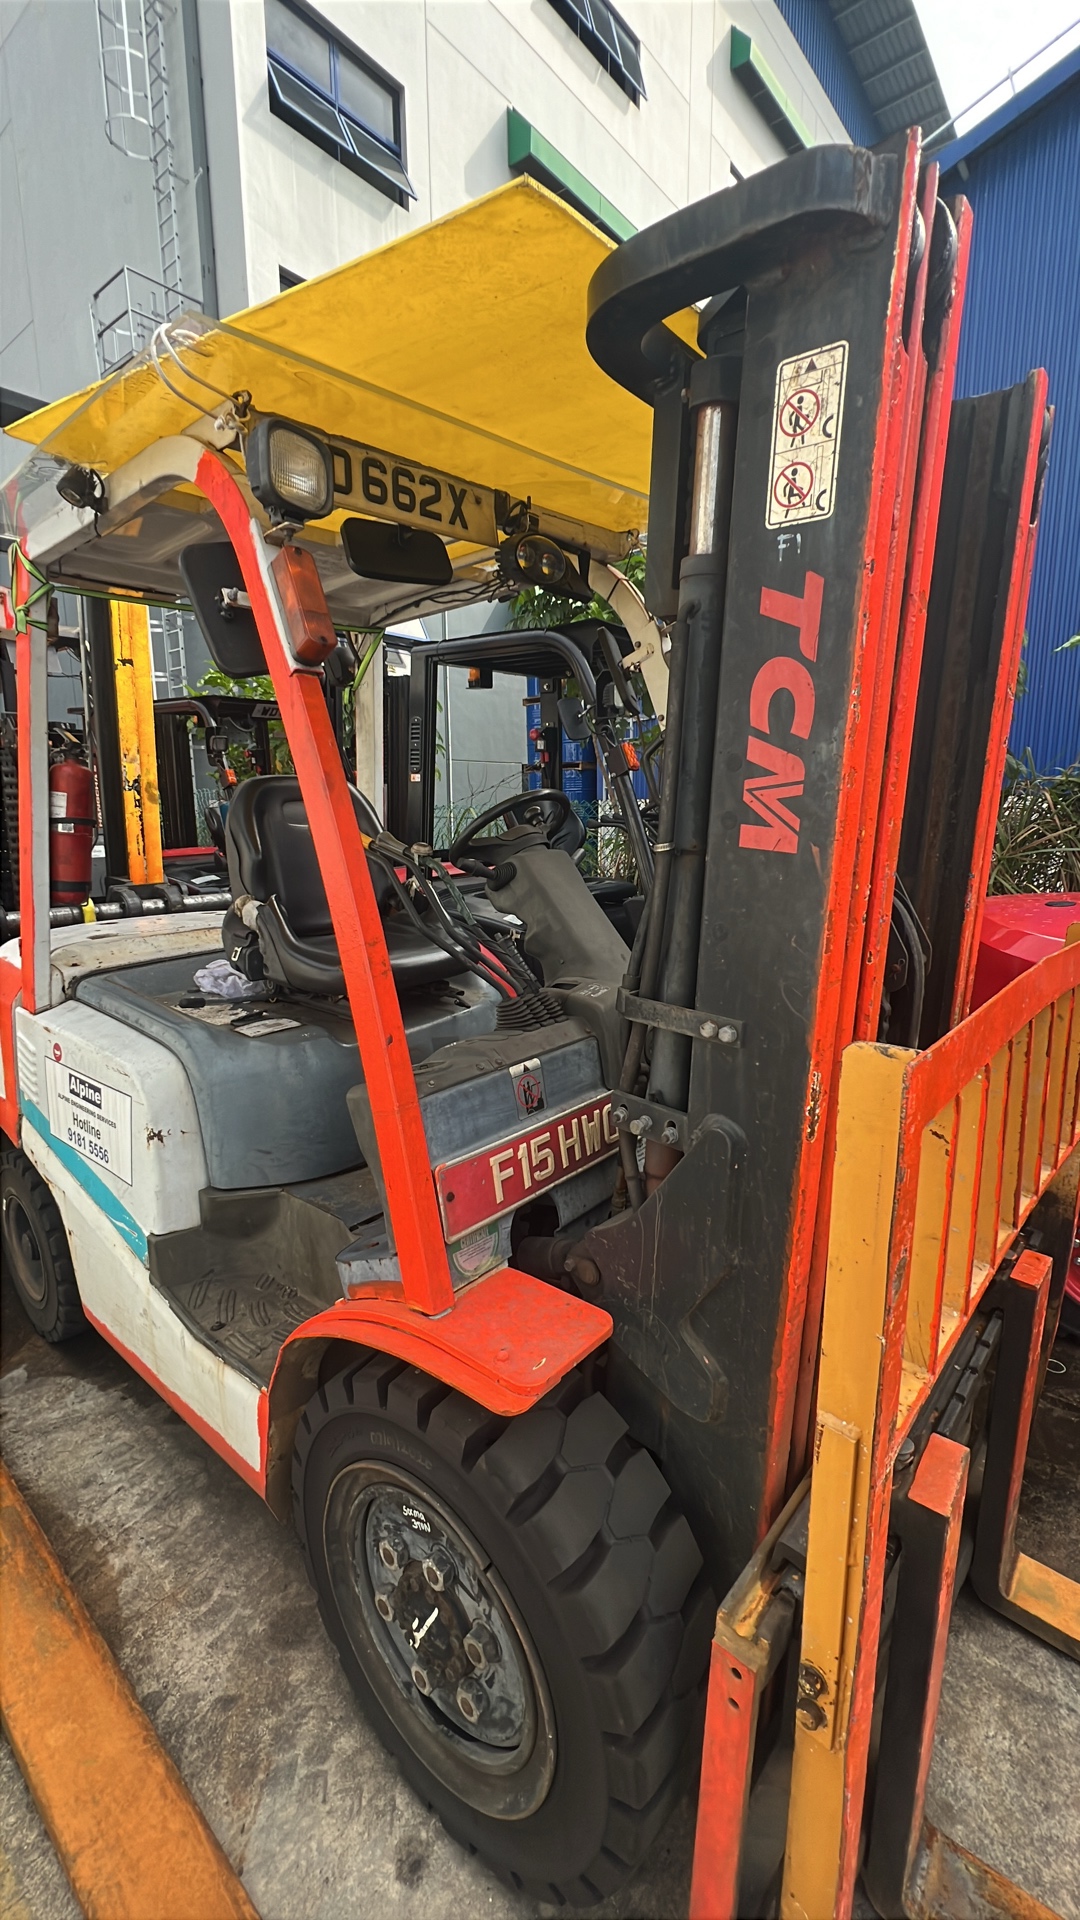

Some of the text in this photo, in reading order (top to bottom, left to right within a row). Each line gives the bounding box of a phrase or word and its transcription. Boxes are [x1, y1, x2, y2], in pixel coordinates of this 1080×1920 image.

[739, 570, 825, 855] TCM
[70, 1076, 101, 1104] Alpine
[58, 1093, 117, 1129] ALPINE ENGINEERING SERVICES
[72, 1111, 102, 1140] Hotline
[67, 1127, 109, 1164] 9181 5556
